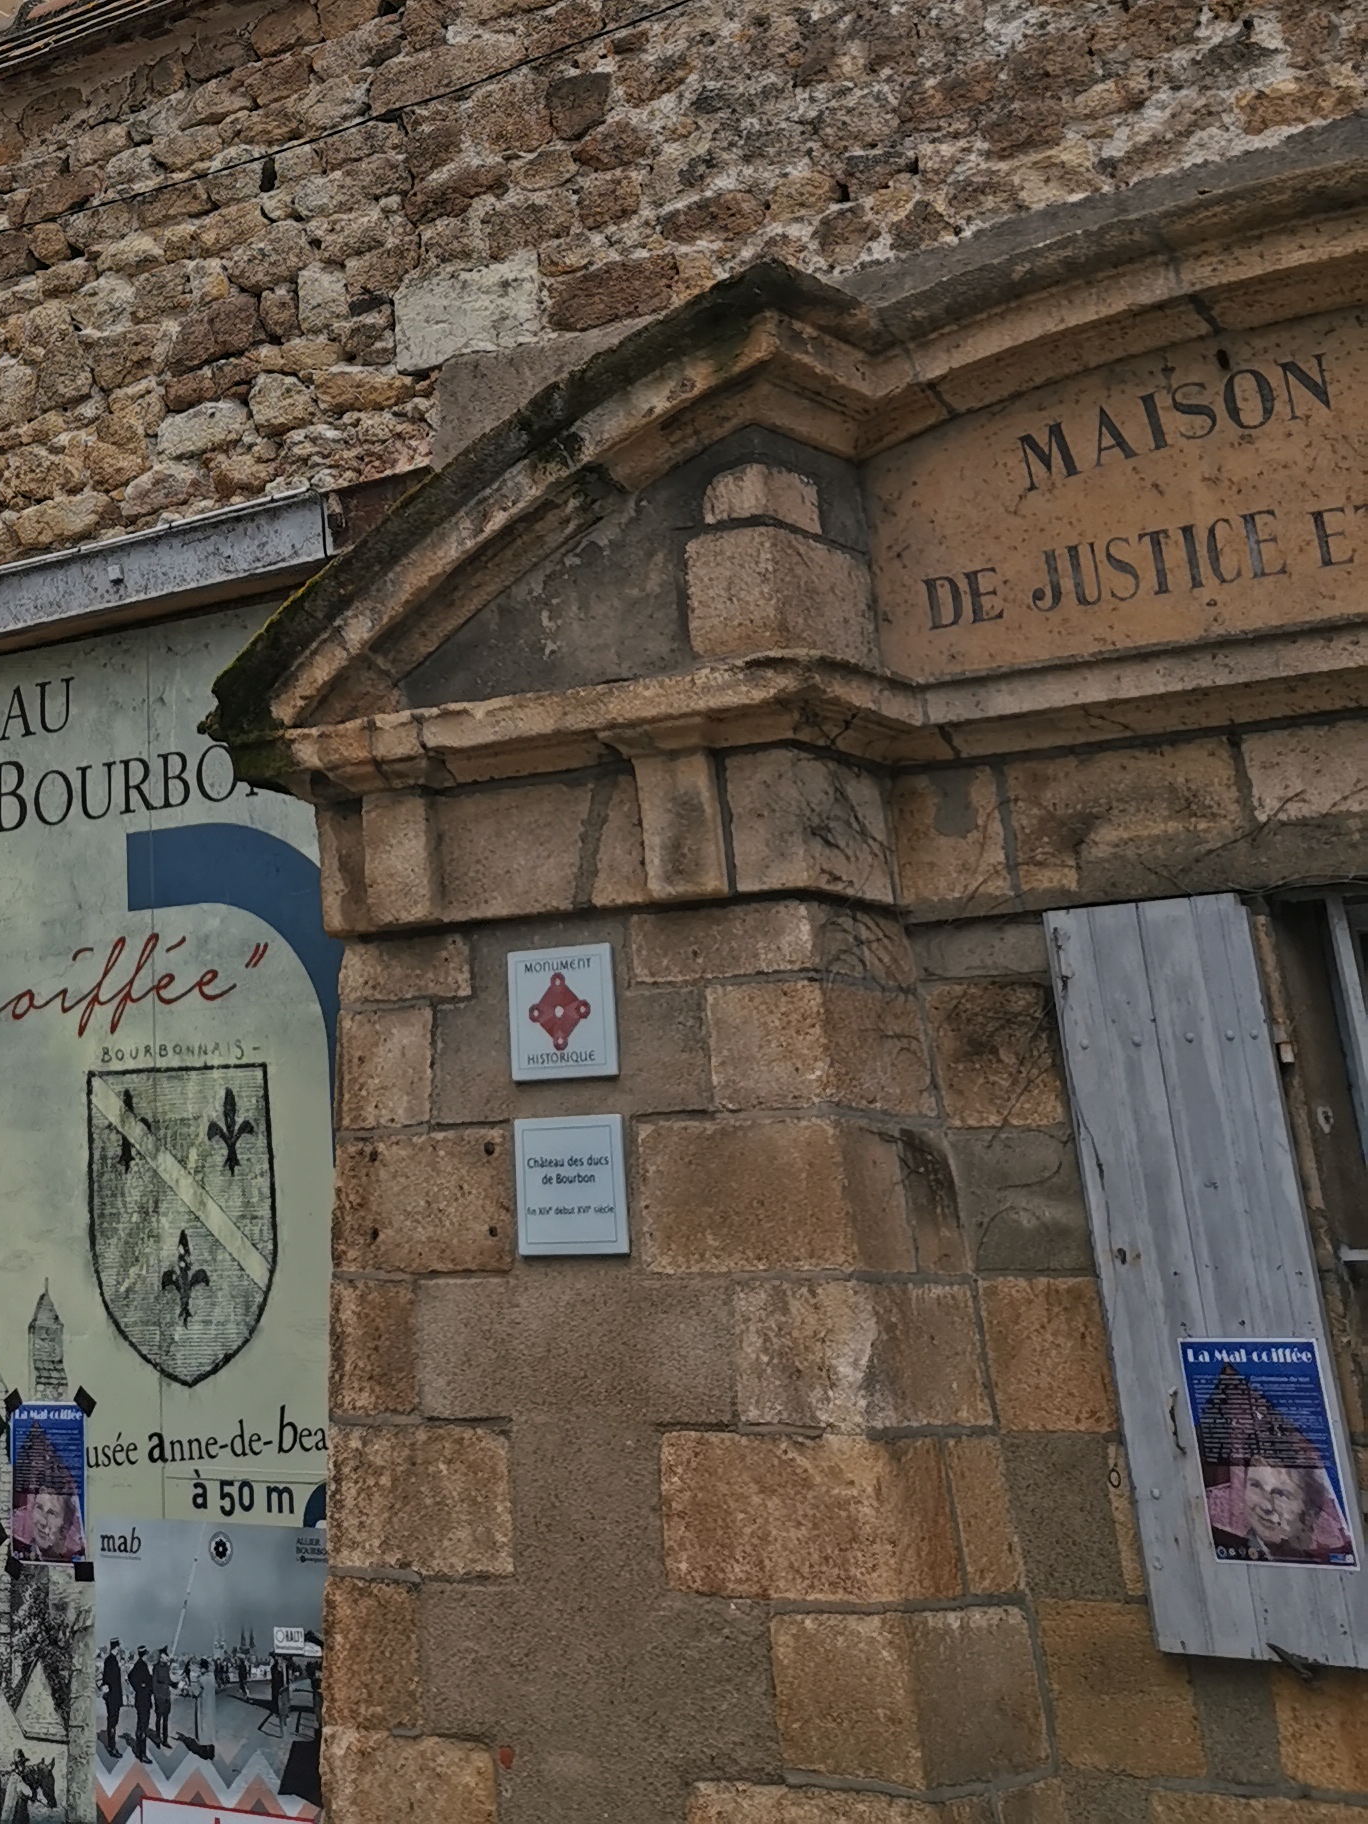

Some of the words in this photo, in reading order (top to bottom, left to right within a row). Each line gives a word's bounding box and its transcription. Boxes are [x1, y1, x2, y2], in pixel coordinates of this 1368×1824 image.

[1017, 351, 1333, 493] MAISON
[921, 566, 1005, 631] DE
[1031, 508, 1289, 613] JUSTICE
[524, 957, 592, 974] MONUMENT
[526, 1049, 596, 1066] HISTORIQUE
[526, 1156, 565, 1169] Château
[567, 1155, 585, 1168] des
[586, 1154, 610, 1167] ducs
[541, 1173, 554, 1186] de
[555, 1172, 596, 1185] Bourbon
[1186, 1348, 1211, 1363] La
[85, 1431, 139, 1469] usée
[147, 1404, 329, 1464] anne-de-bea
[192, 1469, 208, 1510] à
[219, 1479, 255, 1517] 50
[266, 1484, 295, 1515] m
[99, 1527, 142, 1555] mab
